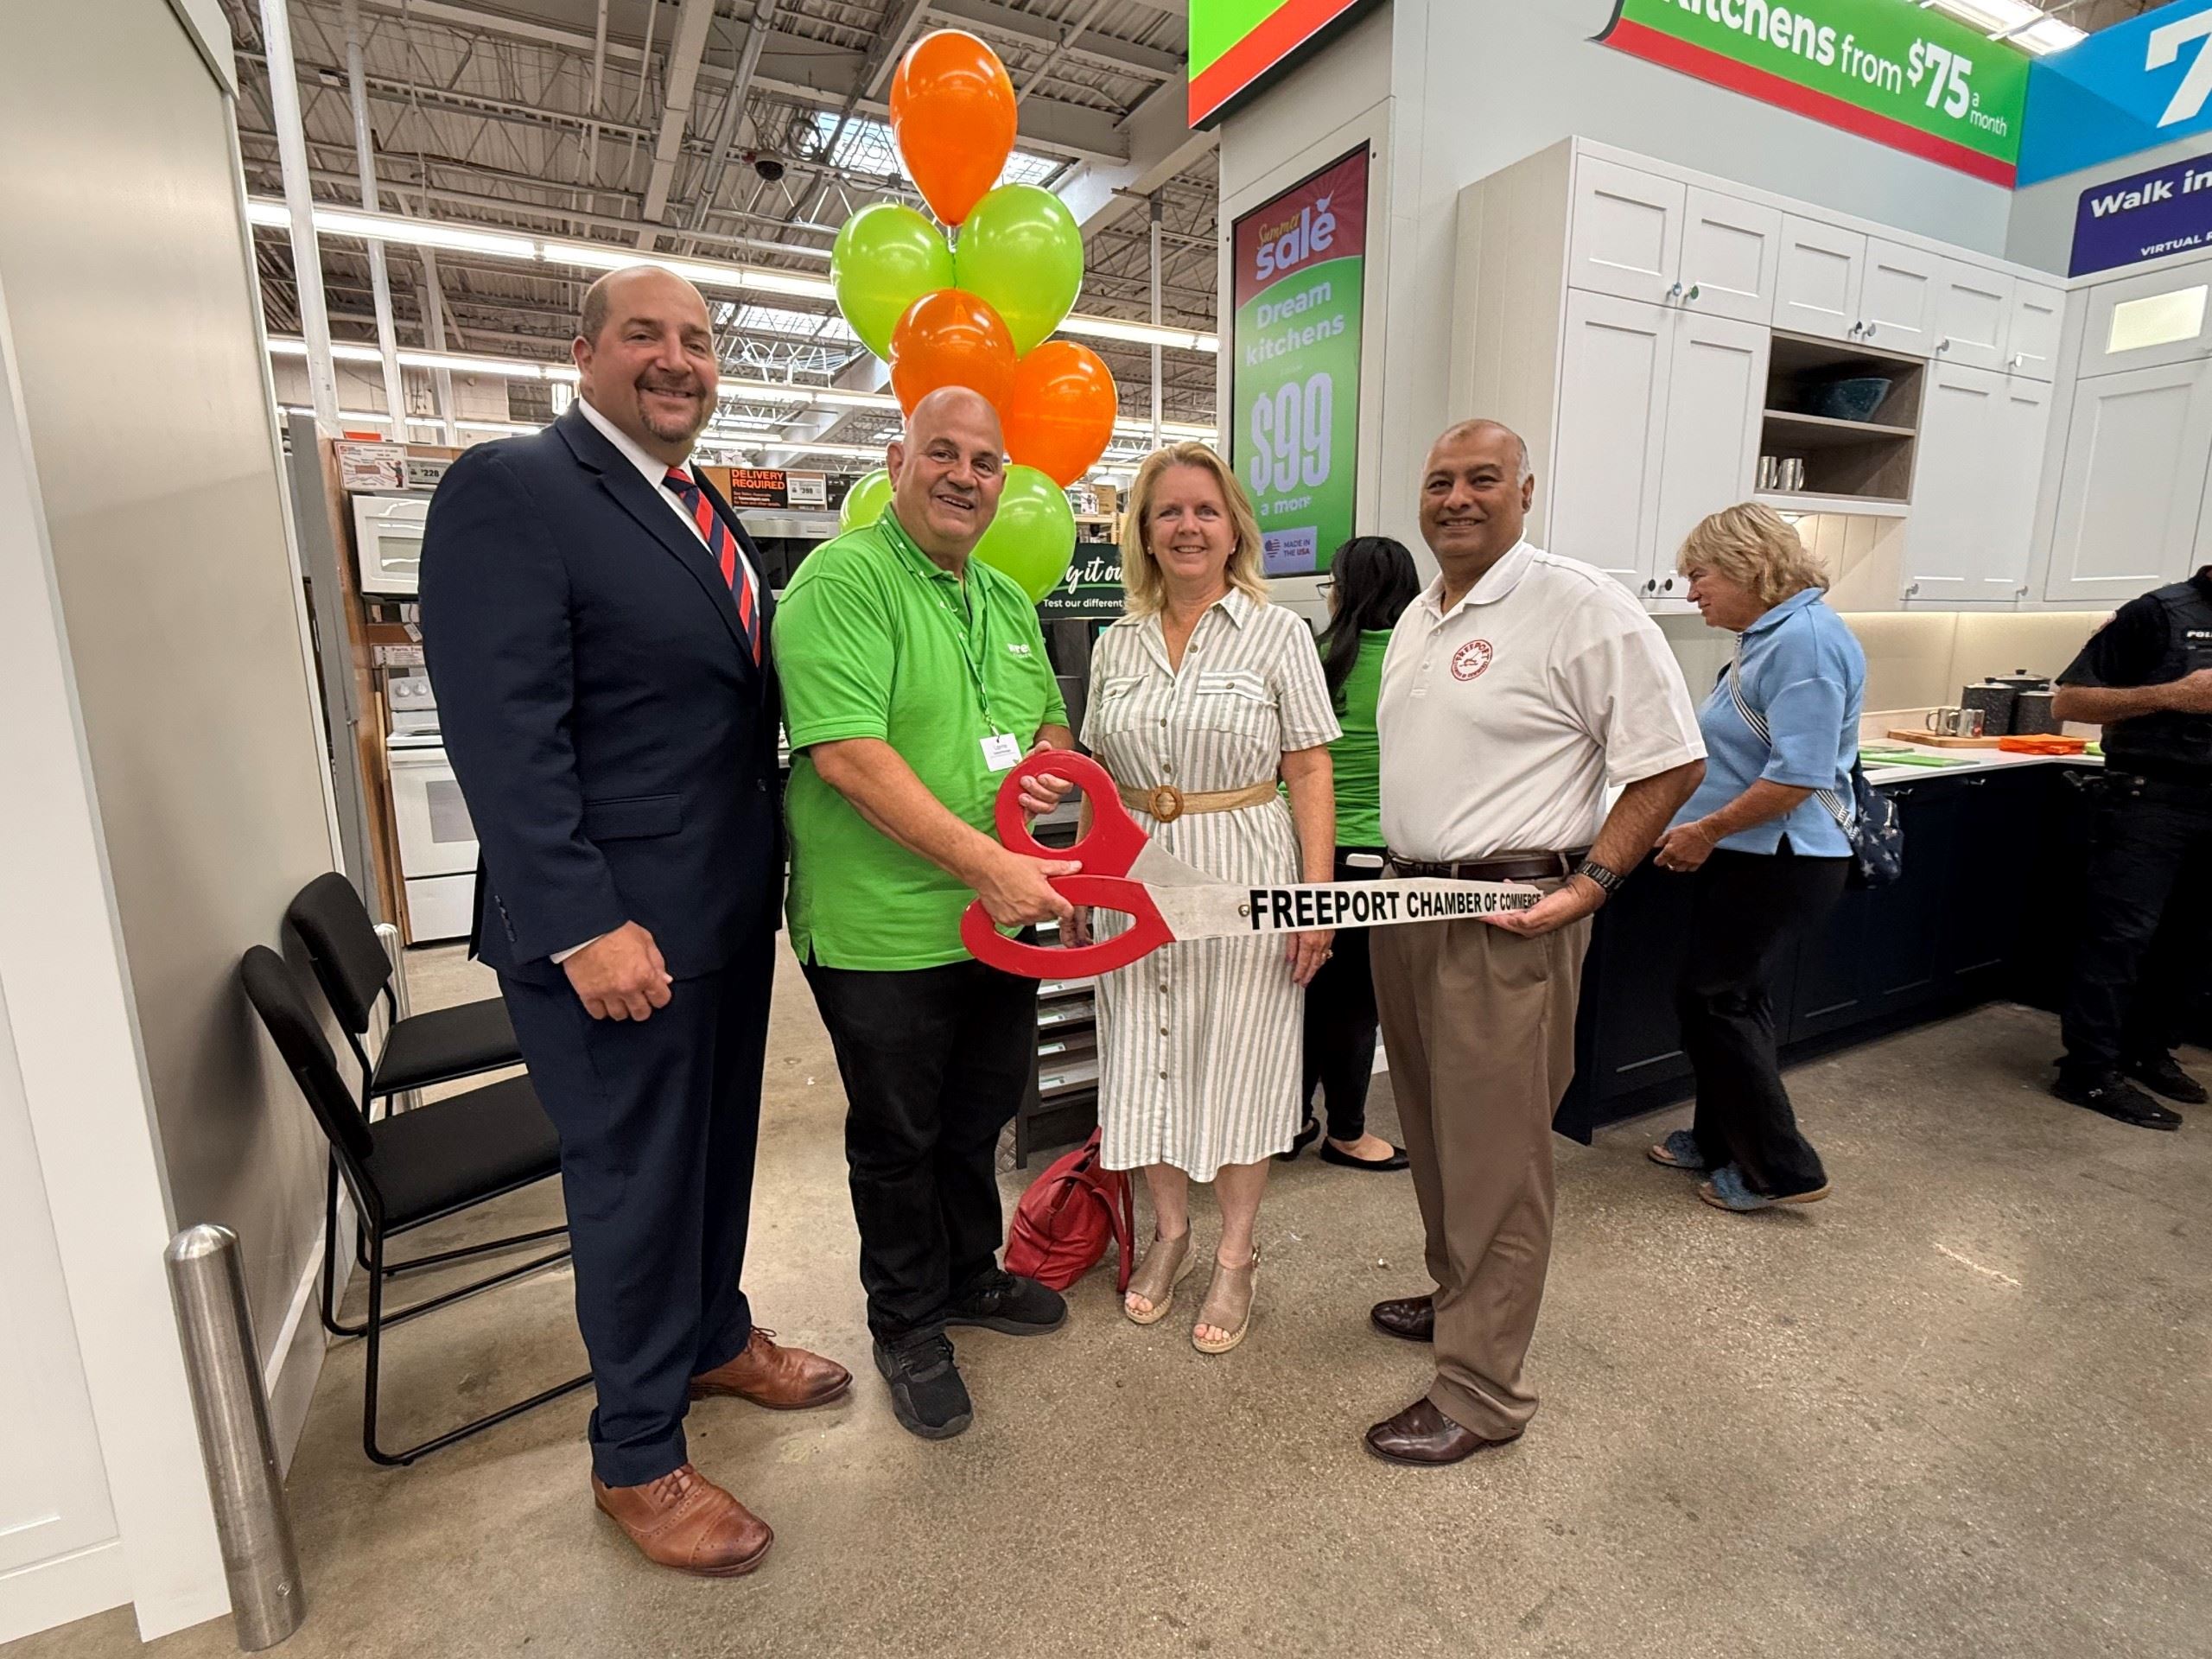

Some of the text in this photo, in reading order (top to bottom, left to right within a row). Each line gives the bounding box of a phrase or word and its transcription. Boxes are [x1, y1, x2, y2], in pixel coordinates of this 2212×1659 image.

[1662, 0, 1973, 119] chens from $75
[1972, 91, 1980, 108] a
[1969, 109, 2007, 137] month
[2090, 180, 2175, 218] Walk
[1255, 206, 1336, 281] sale
[2140, 235, 2202, 257] VIRTUAL
[1256, 281, 1332, 329] Dream
[1246, 314, 1345, 366] kitchens
[1250, 372, 1333, 497] $99
[731, 469, 784, 481] DELIVERY
[732, 479, 785, 490] REQUIRED
[1283, 539, 1303, 549] MADE
[1283, 548, 1311, 558] THE USA
[1084, 556, 1104, 582] it
[1043, 599, 1063, 607] Test
[1083, 598, 1122, 607] different
[1249, 889, 1400, 931] FREEPORT
[1407, 891, 1483, 918] CHAMBER
[1484, 893, 1497, 912] OF
